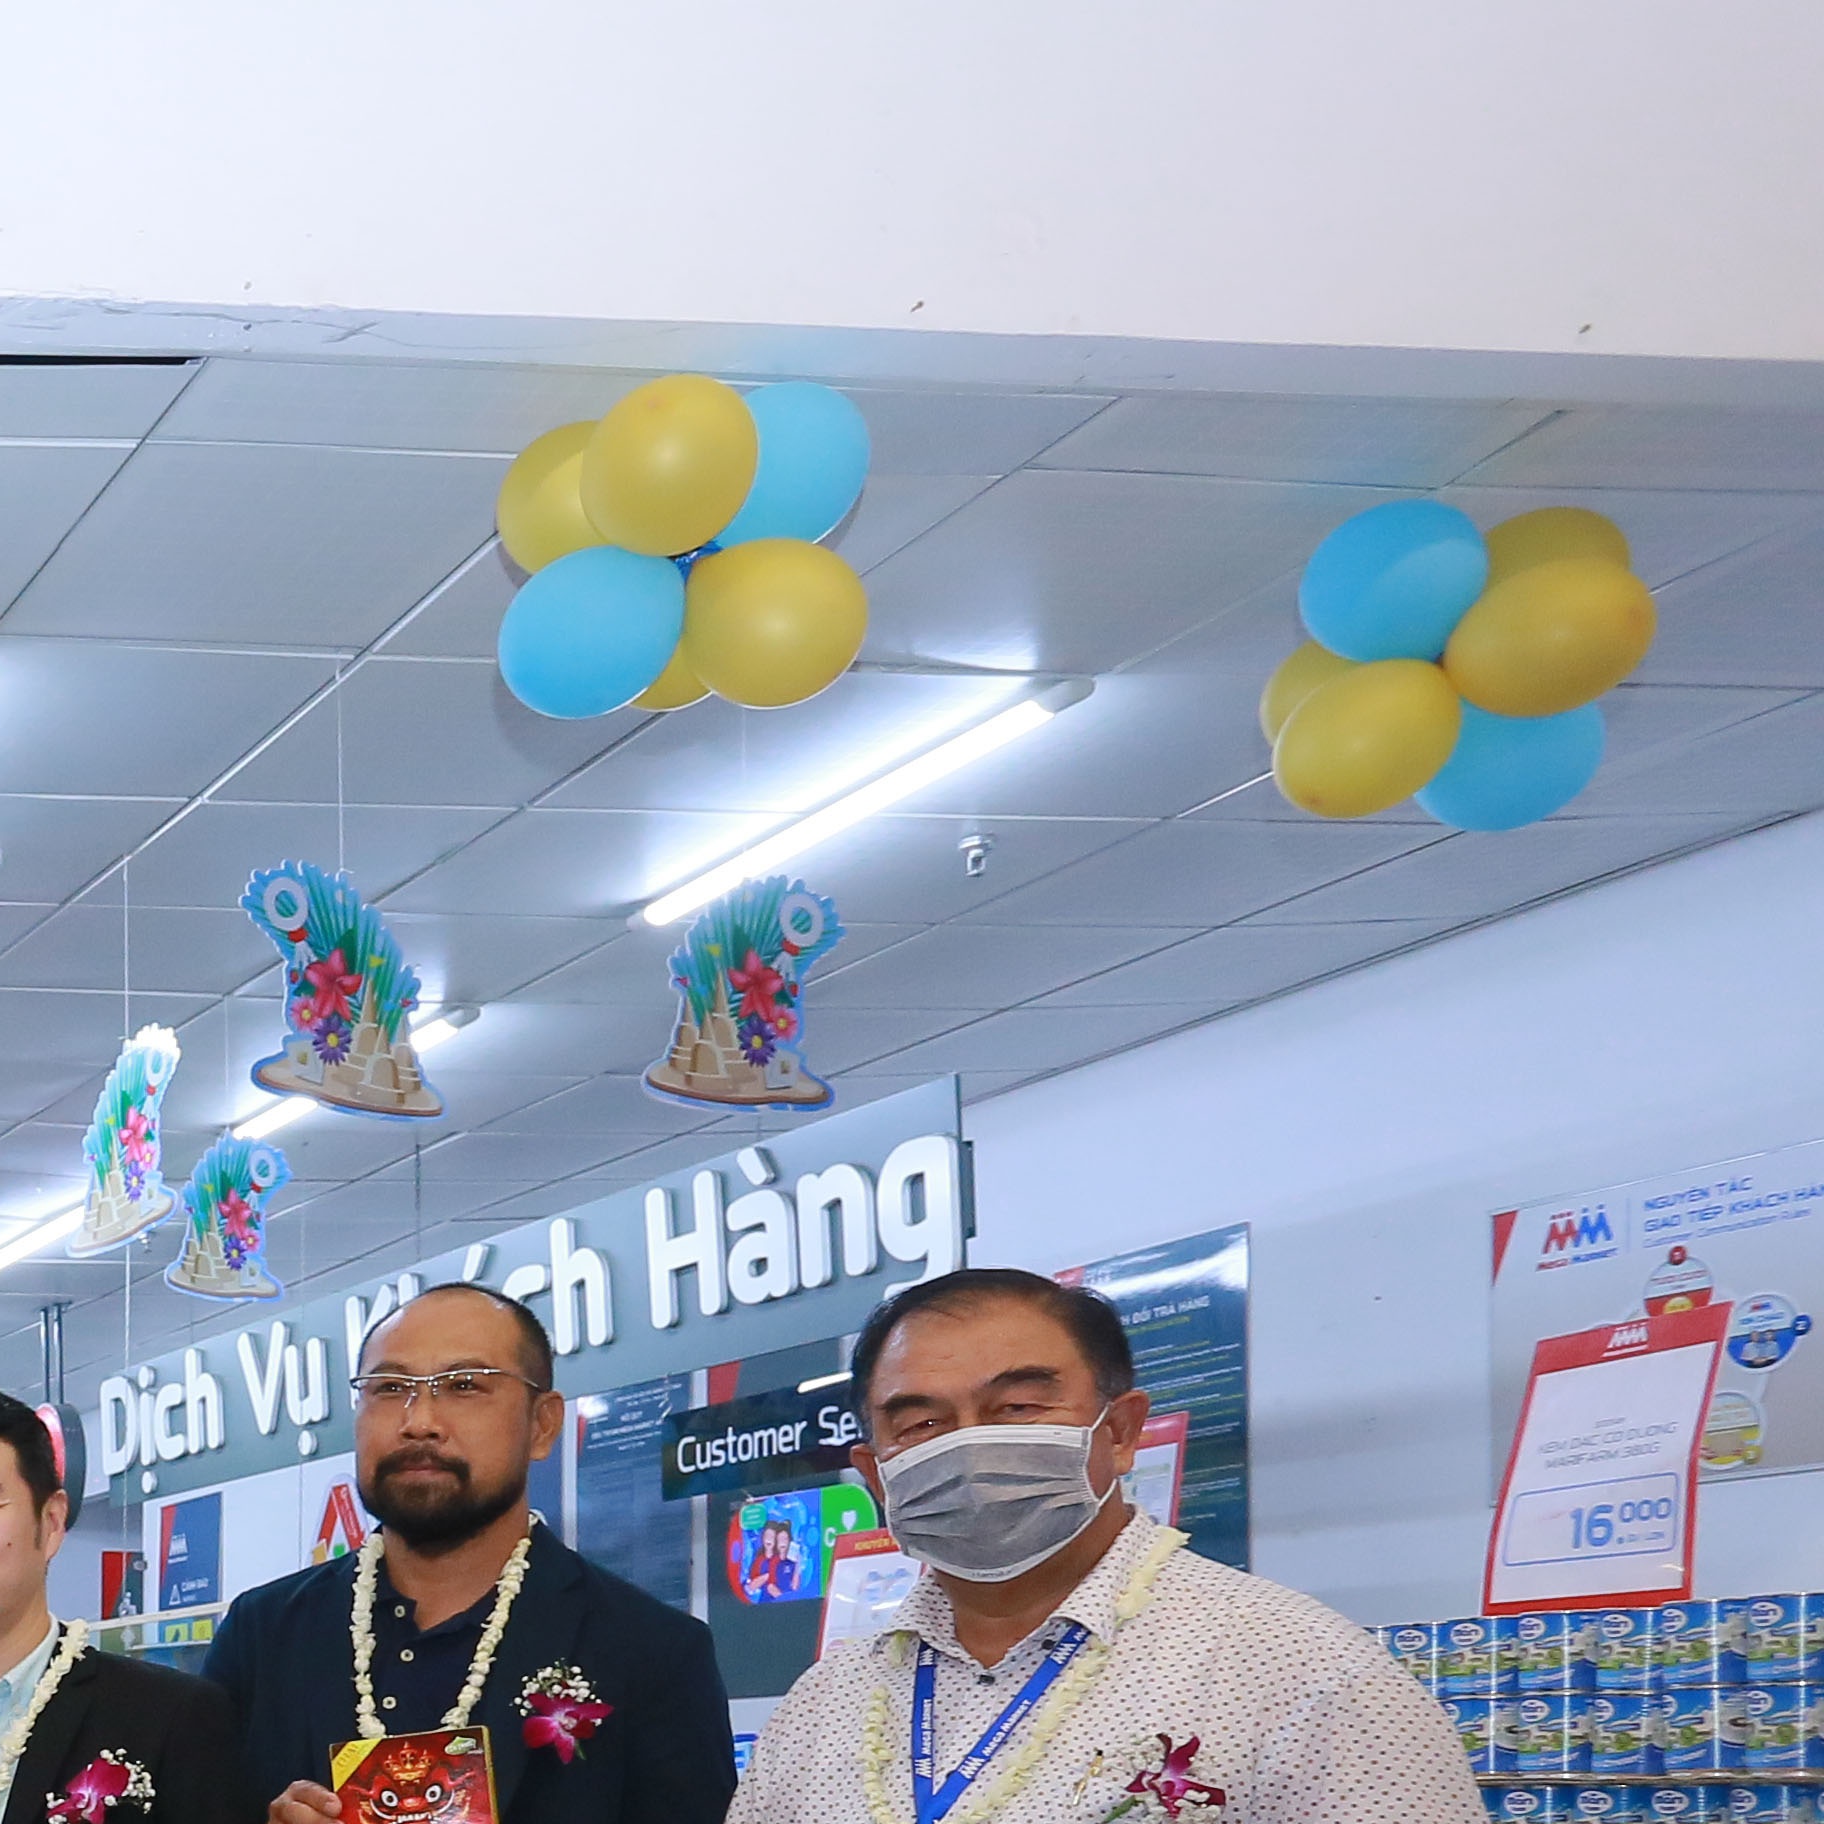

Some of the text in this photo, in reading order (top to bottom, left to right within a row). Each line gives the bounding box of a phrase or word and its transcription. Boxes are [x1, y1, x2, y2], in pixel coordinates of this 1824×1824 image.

[102, 1347, 224, 1495] Dịch
[235, 1320, 331, 1456] Vụ
[643, 1131, 961, 1330] Hàng
[675, 1405, 863, 1474] Customer Se
